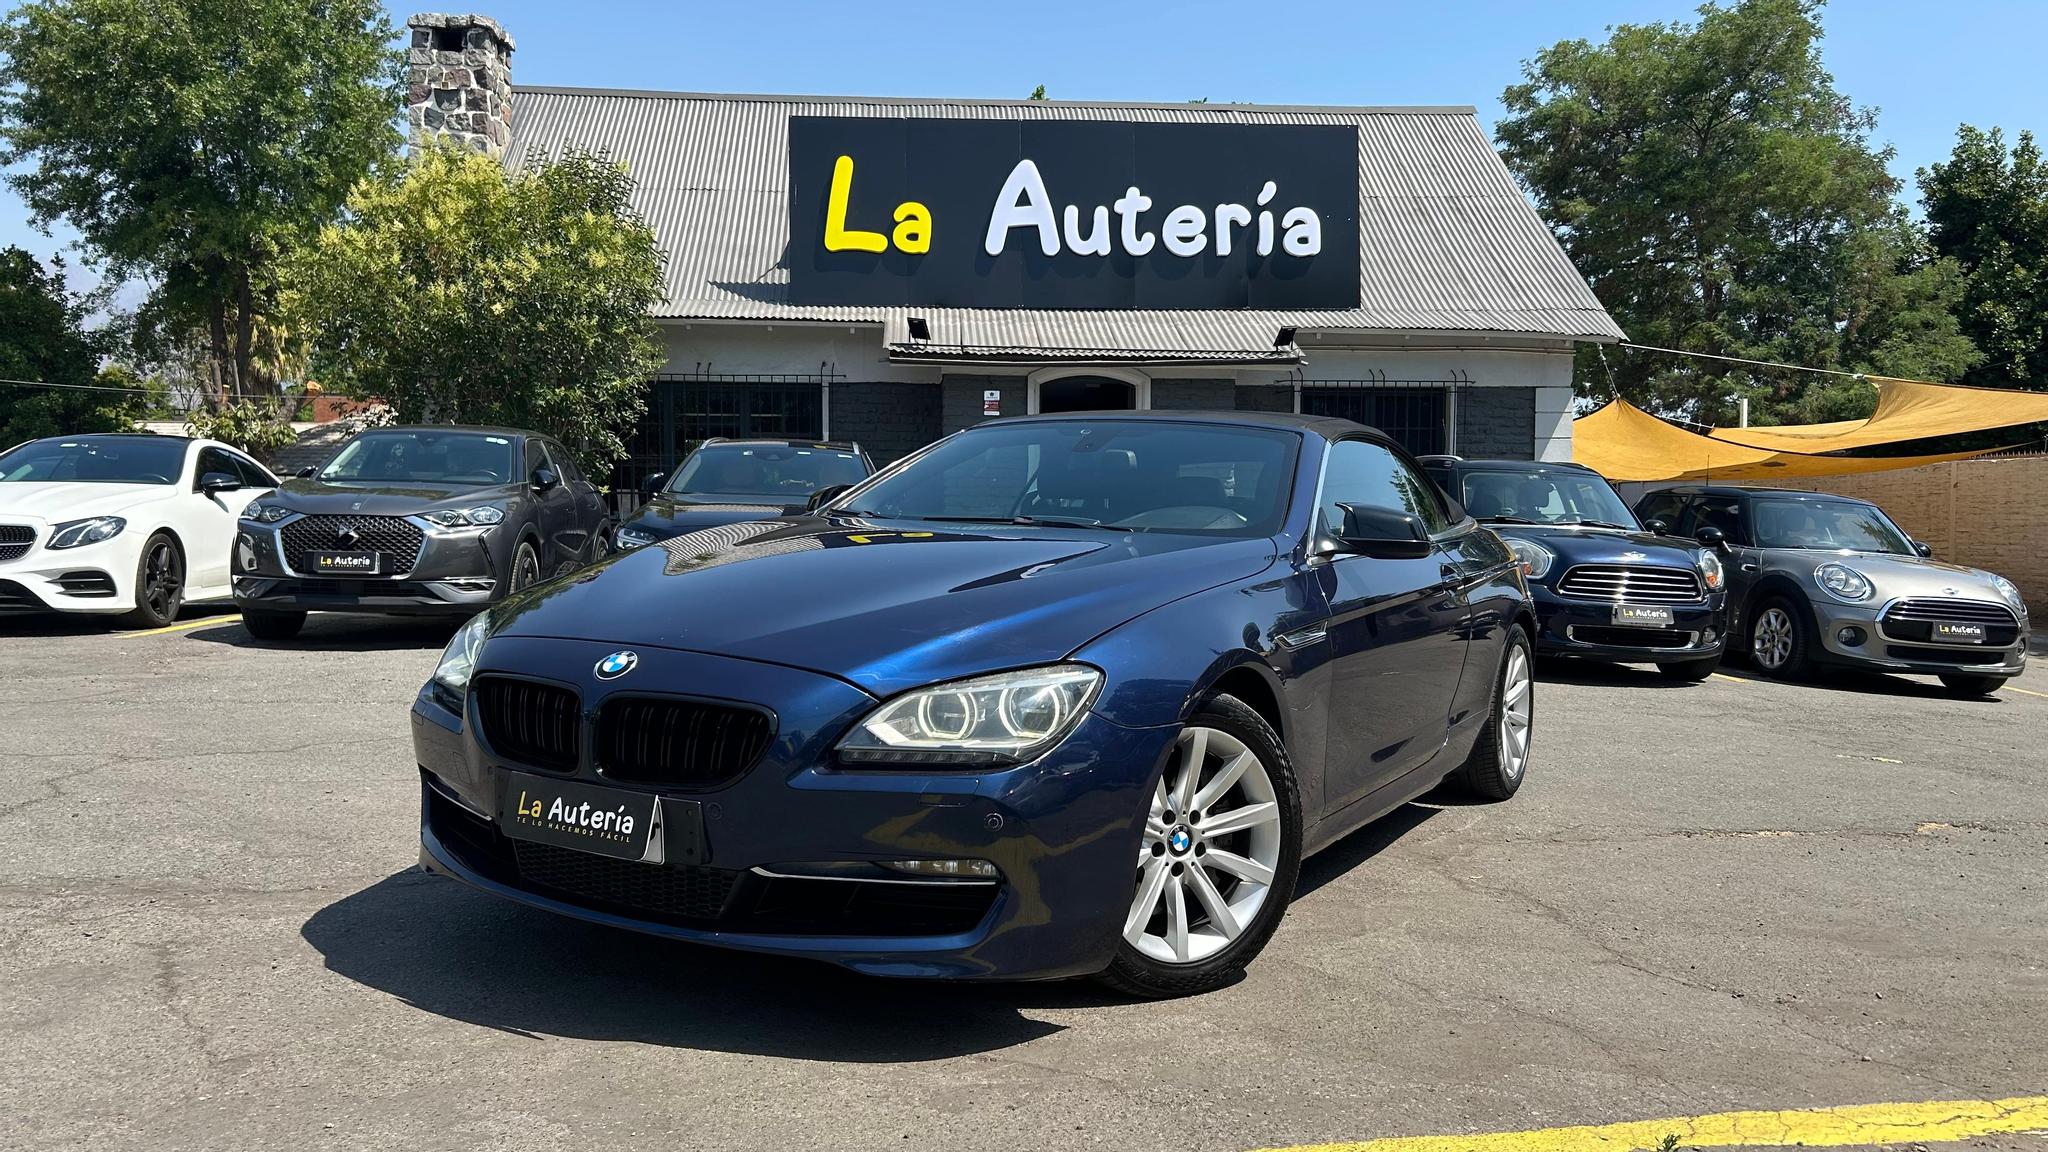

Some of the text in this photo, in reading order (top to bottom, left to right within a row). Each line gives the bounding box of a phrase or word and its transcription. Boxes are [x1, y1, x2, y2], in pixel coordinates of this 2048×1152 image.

[824, 155, 1322, 258] La Autería
[320, 556, 332, 564] La
[1623, 608, 1634, 617] La
[1939, 624, 1950, 633] La
[517, 791, 634, 834] La Autería
[516, 816, 526, 824] TE
[548, 822, 594, 836] HACEMOS
[600, 832, 631, 843] FÁCIL
